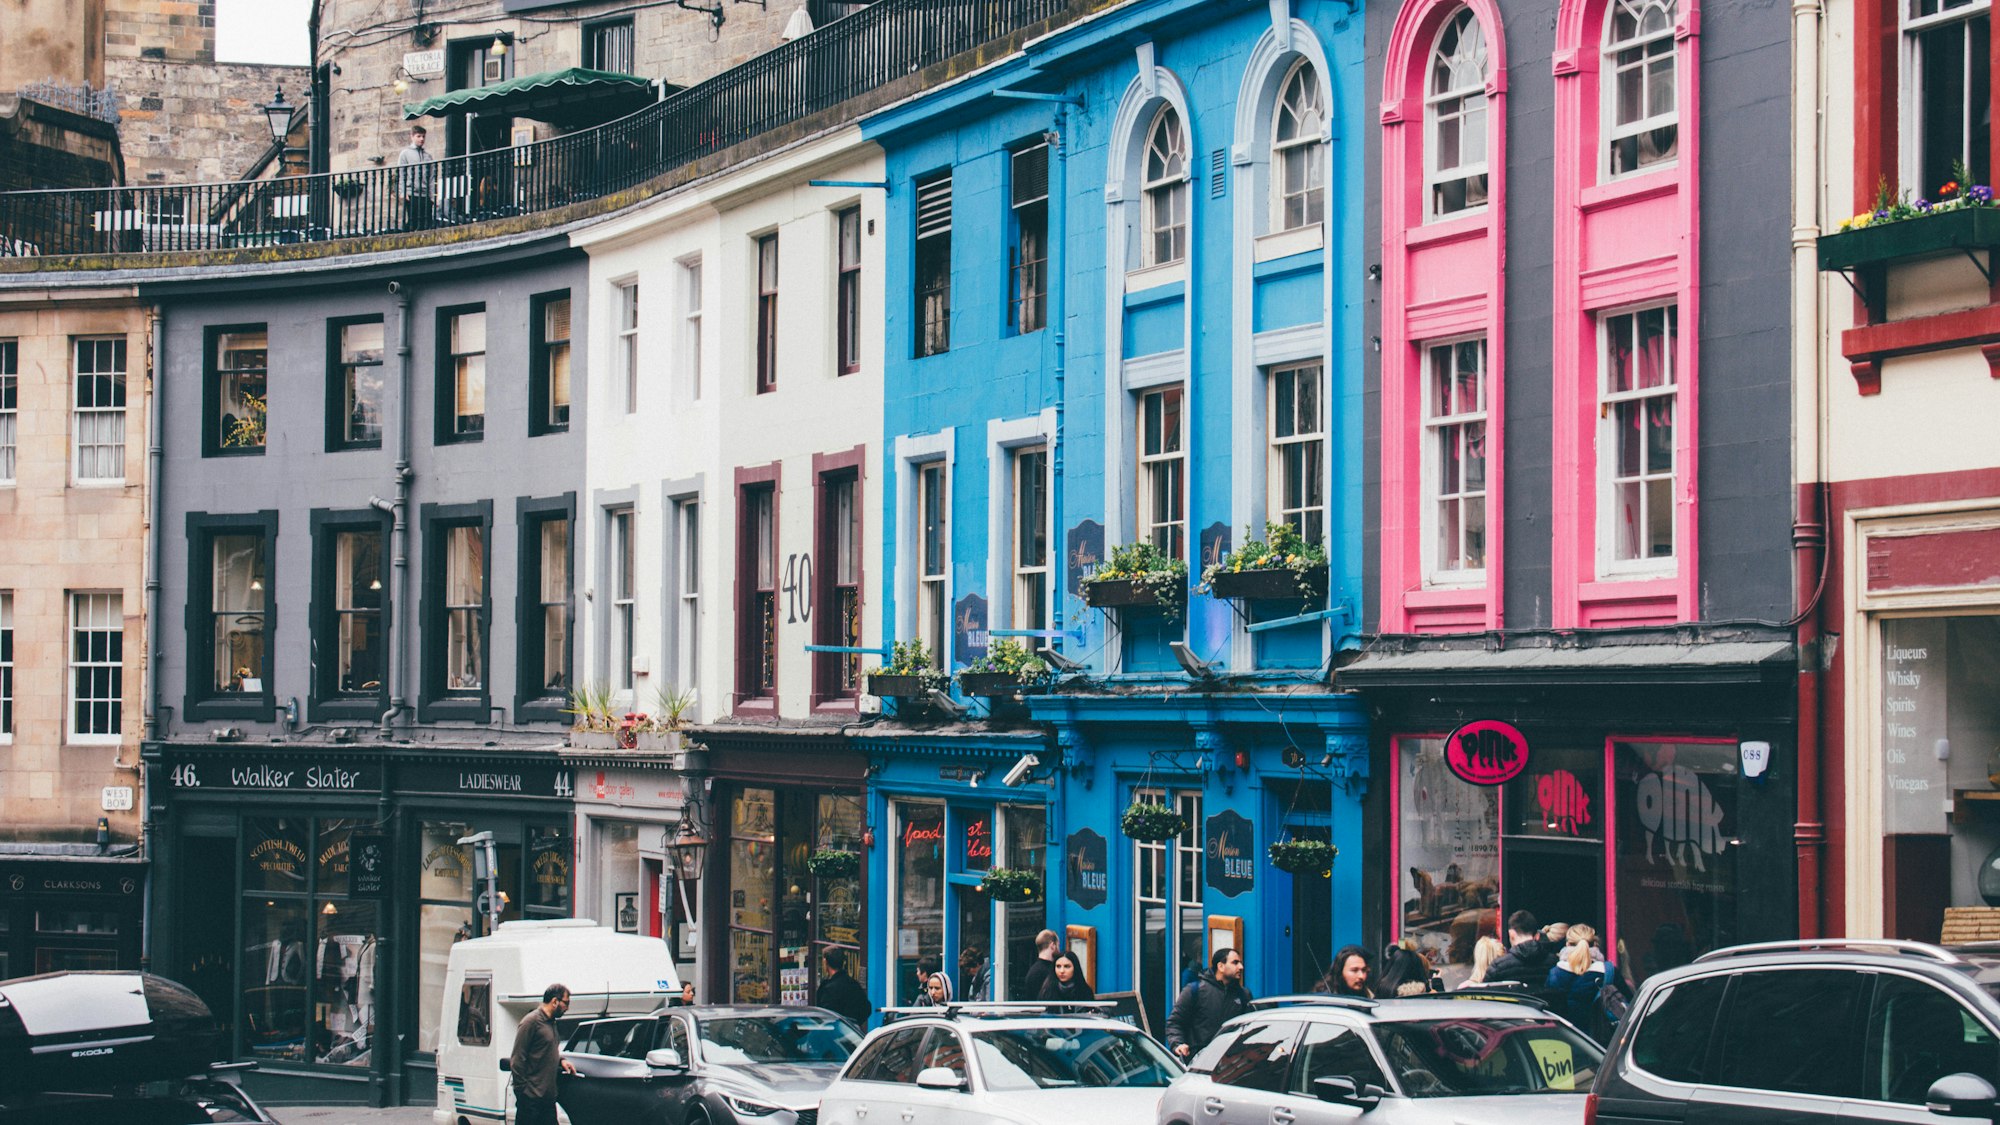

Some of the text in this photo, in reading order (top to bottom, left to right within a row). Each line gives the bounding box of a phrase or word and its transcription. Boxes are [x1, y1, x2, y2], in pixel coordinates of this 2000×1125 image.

[406, 51, 442, 63] VICTORIA
[408, 61, 441, 72] TERRACE
[782, 553, 812, 624] 40
[1887, 645, 1927, 664] Liqueurs
[1887, 671, 1921, 689] Whisky
[1887, 697, 1916, 715] Spirits
[1888, 722, 1917, 738] Wines
[1887, 748, 1906, 764] Oils
[170, 764, 200, 787] 46.
[231, 765, 360, 788] Walker Slater
[460, 773, 521, 791] LADIESWEAR
[554, 771, 573, 796] 44.
[1888, 774, 1929, 793] Vinegars
[105, 789, 128, 798] WEST
[107, 799, 127, 807] BOW
[250, 840, 306, 863] SCOTTISH TWEED
[1224, 858, 1252, 879] BLEUE
[44, 880, 101, 890] CLARKSONS
[1082, 871, 1106, 891] BLEUE
[72, 1048, 113, 1058] exodus
[1543, 1051, 1572, 1081] bin
